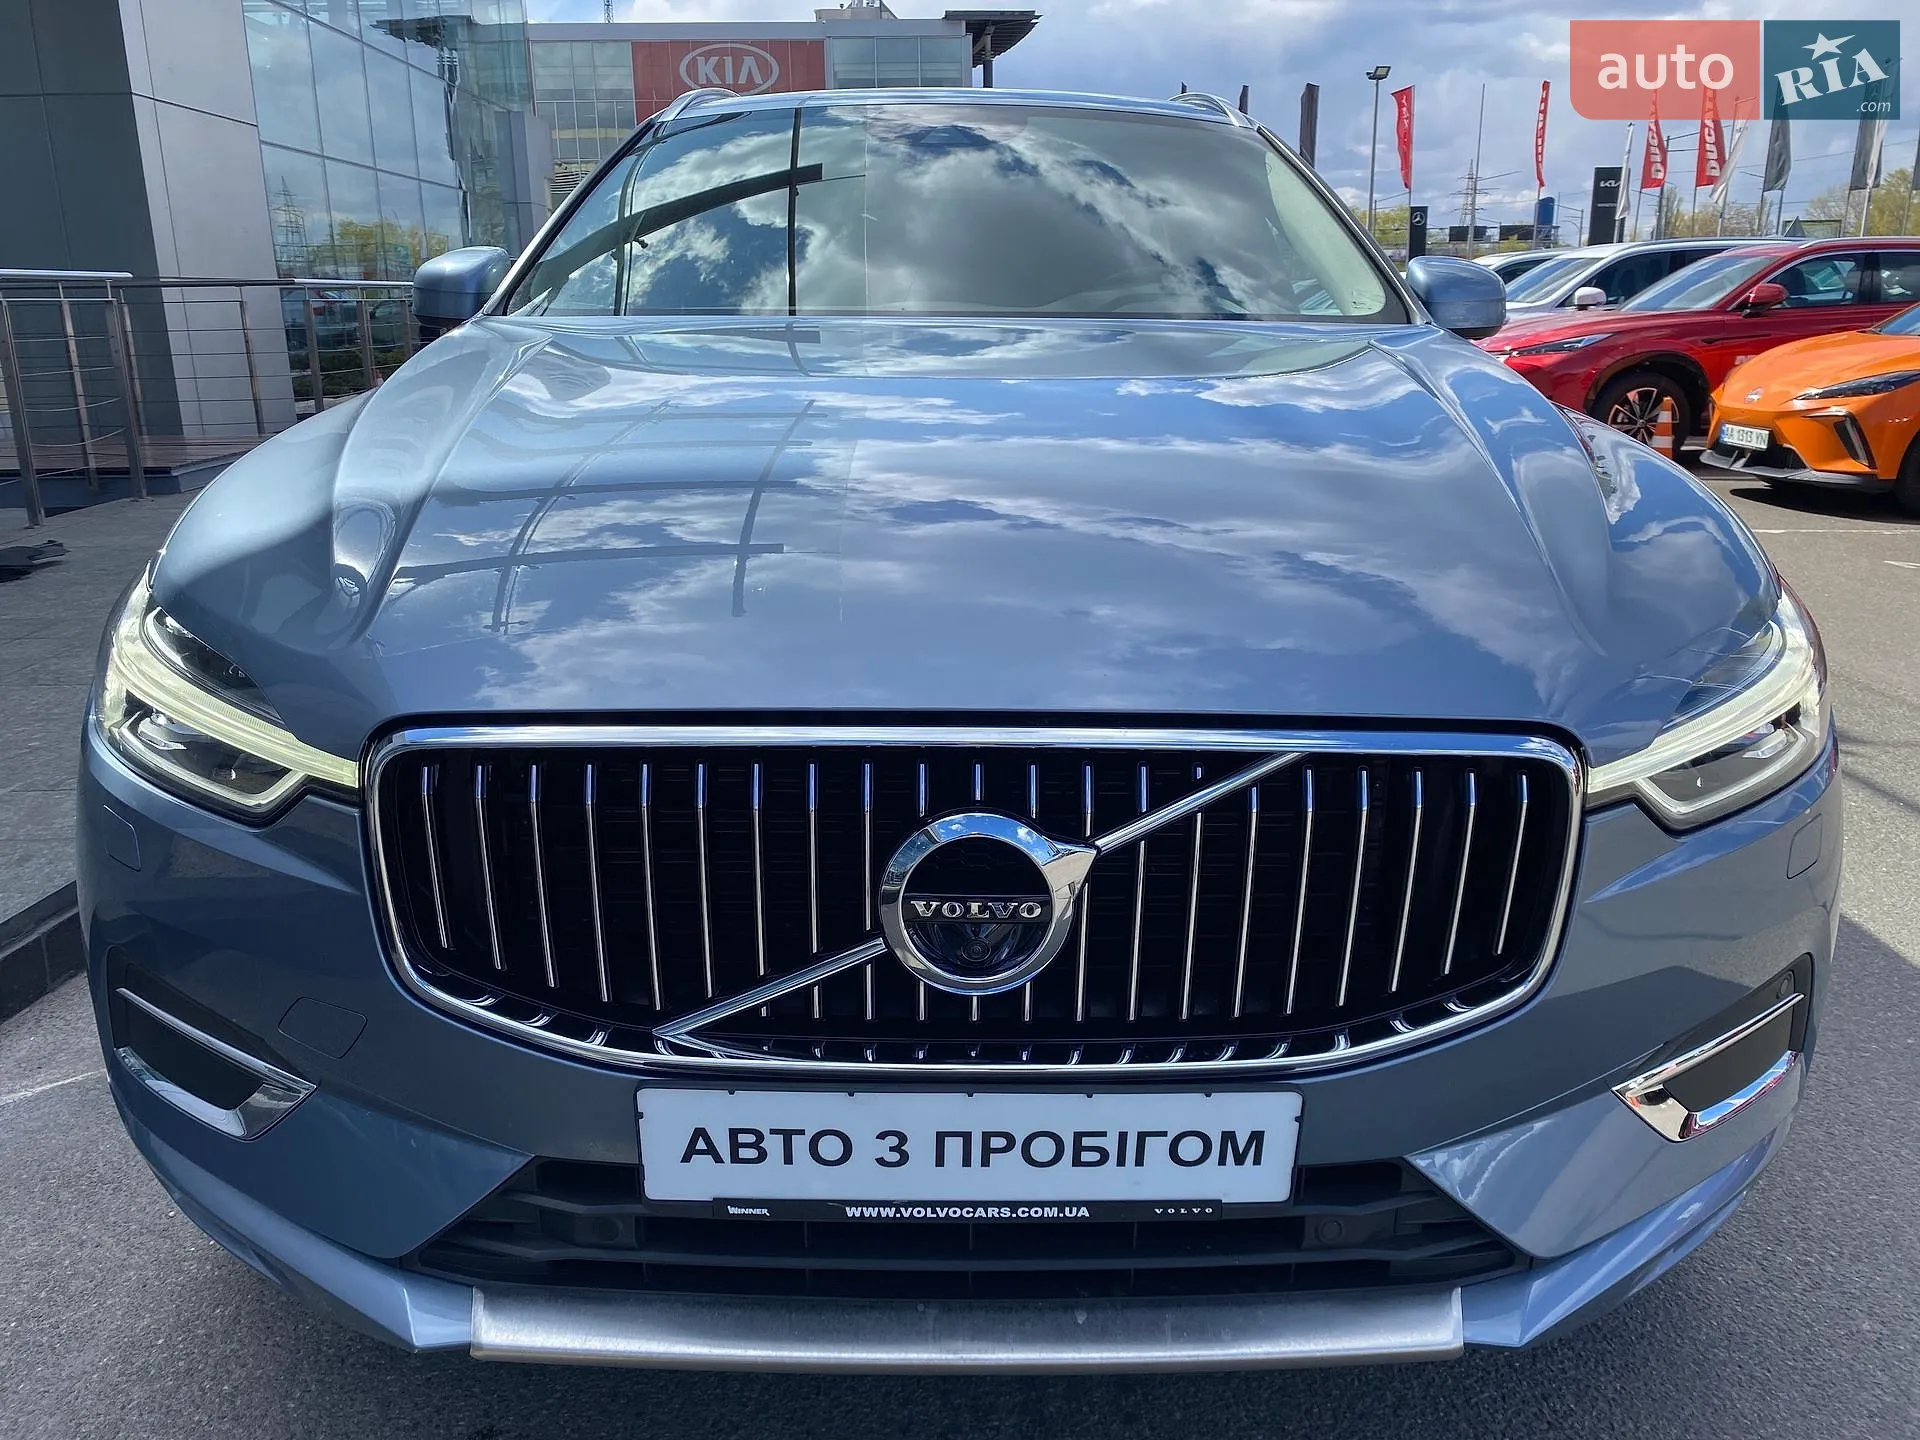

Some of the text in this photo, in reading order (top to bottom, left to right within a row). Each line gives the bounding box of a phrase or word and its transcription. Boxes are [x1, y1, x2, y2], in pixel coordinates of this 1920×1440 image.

[695, 56, 764, 84] KIA
[910, 900, 1042, 919] VOLVO
[680, 1127, 853, 1167] АВТО
[934, 1130, 1266, 1168] ПРОБІГОМ
[727, 1205, 770, 1216] WINNER
[845, 1206, 1090, 1218] WWW.VOLVOCARS.COM.UA
